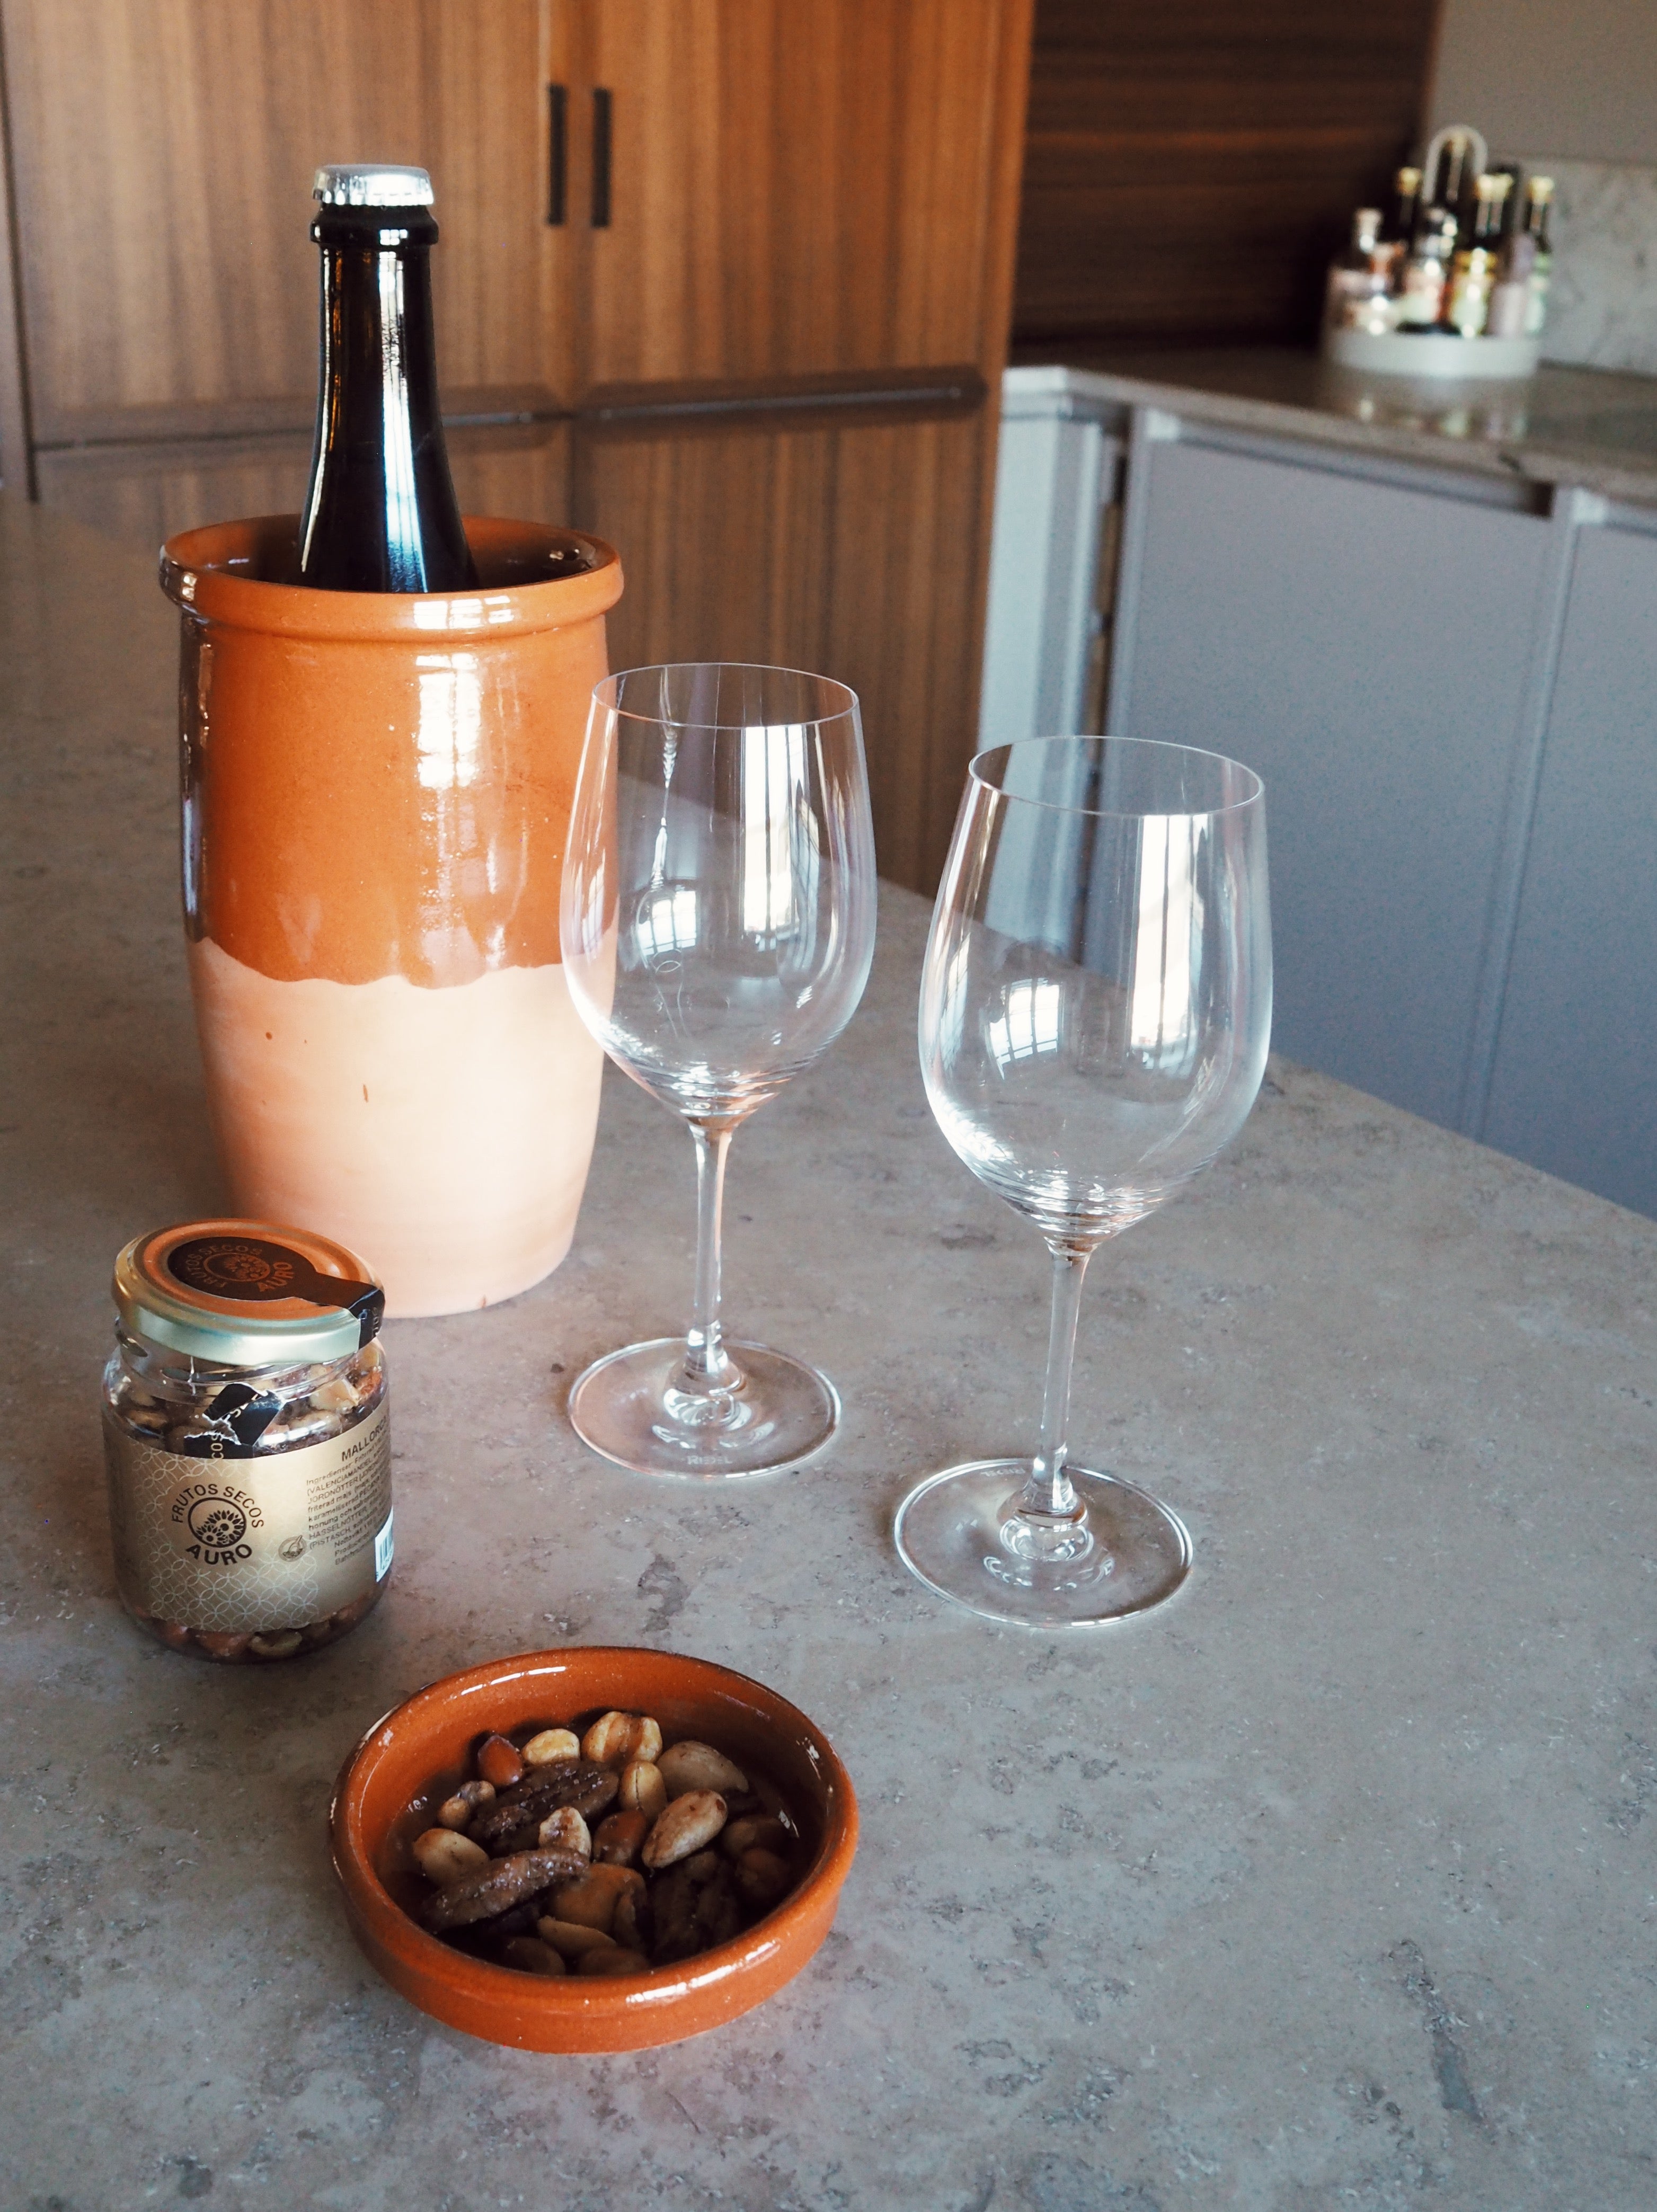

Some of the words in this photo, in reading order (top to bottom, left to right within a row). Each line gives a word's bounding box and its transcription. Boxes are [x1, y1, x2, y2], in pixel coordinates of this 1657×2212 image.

[199, 1245, 263, 1255] SECOS
[186, 1254, 228, 1288] FRUTOS
[257, 1262, 295, 1292] AURO
[687, 1455, 733, 1464] RIEDEL
[171, 1483, 218, 1523] FRUTOS
[223, 1486, 264, 1528] SECOS
[186, 1544, 252, 1566] AURO
